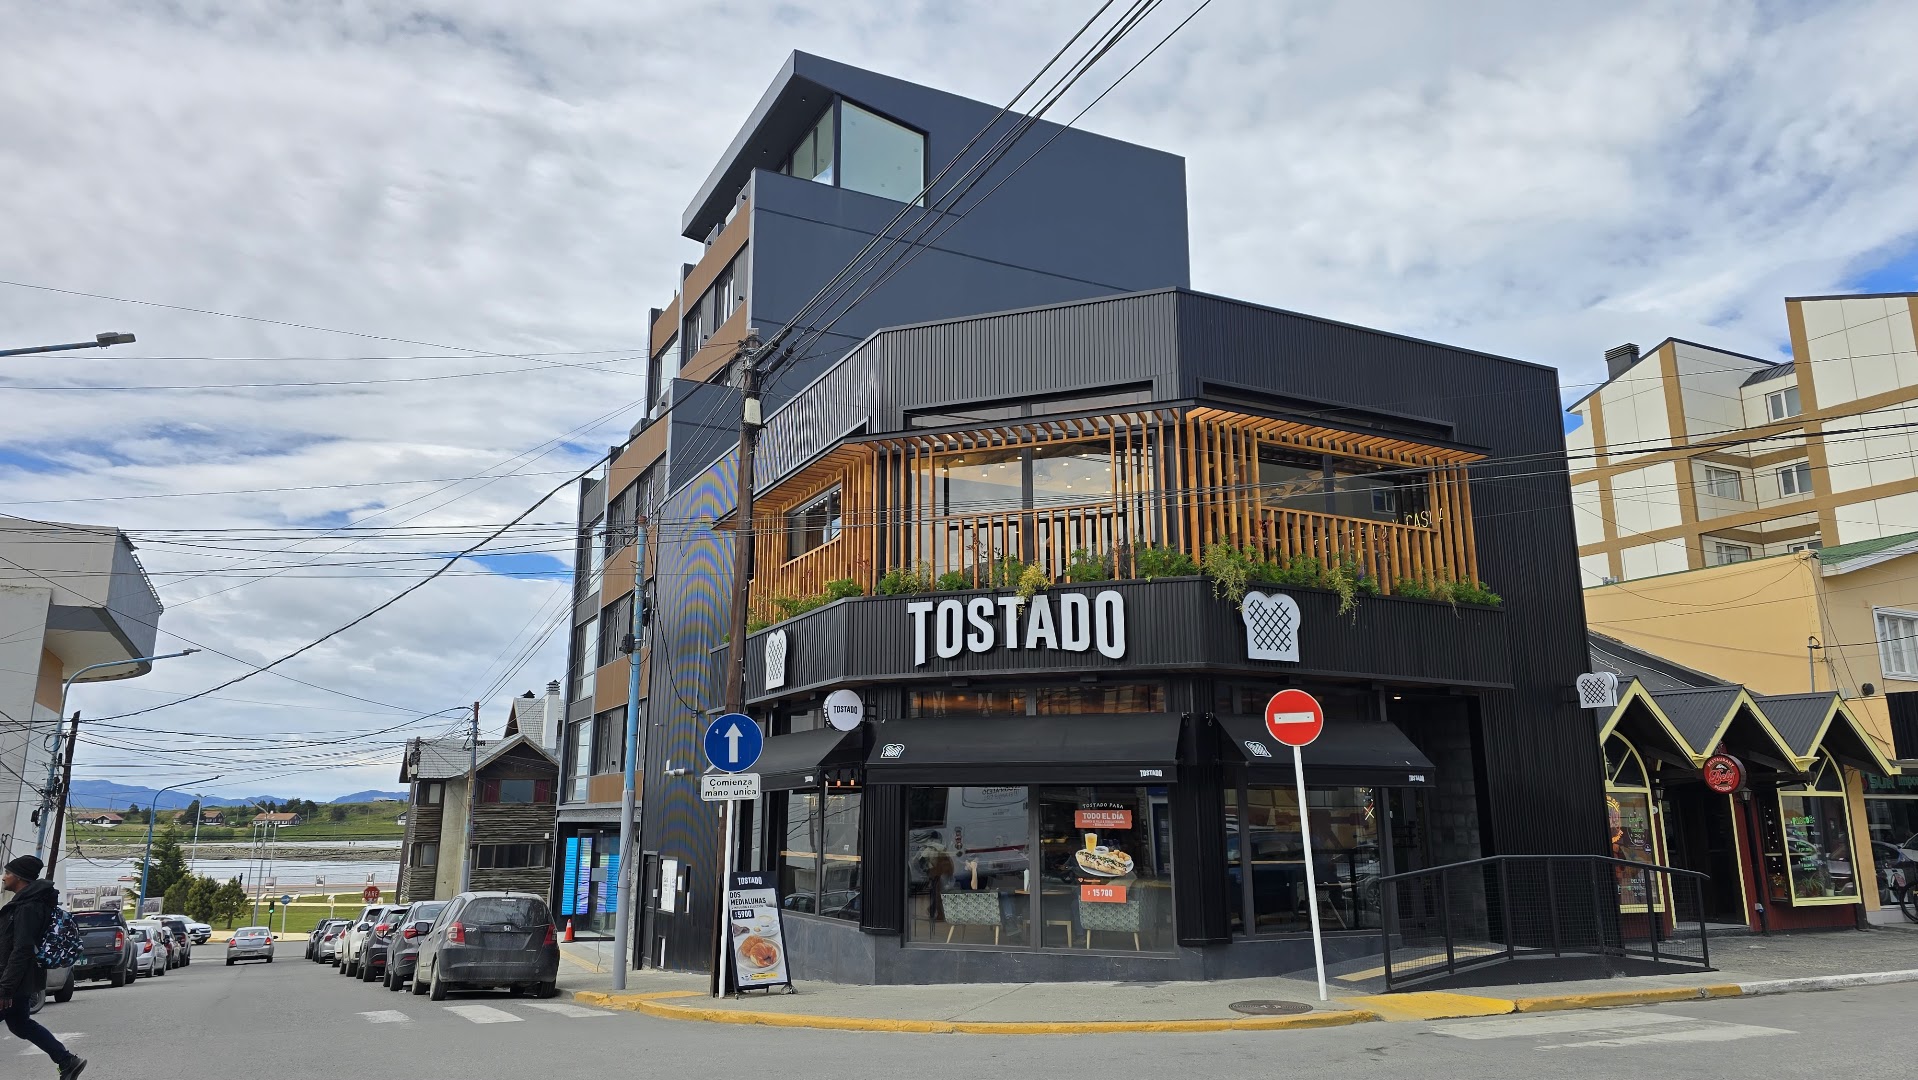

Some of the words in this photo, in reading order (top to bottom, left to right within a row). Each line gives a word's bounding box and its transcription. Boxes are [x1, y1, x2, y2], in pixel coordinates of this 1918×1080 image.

[907, 590, 1126, 667] TOSTADO
[833, 705, 858, 715] TOSTADO
[1707, 757, 1735, 767] RESTAURANT
[1139, 769, 1163, 777] TOSTADO
[709, 778, 753, 787] Comienza
[734, 789, 757, 797] unica
[1109, 802, 1124, 810] PARA
[1083, 812, 1101, 820] TODO
[1101, 812, 1111, 820] EL
[1112, 811, 1124, 820] DÍA
[737, 876, 763, 886] TOSTADO
[729, 891, 741, 899] DOS
[730, 897, 767, 906] MEDIALUNAS
